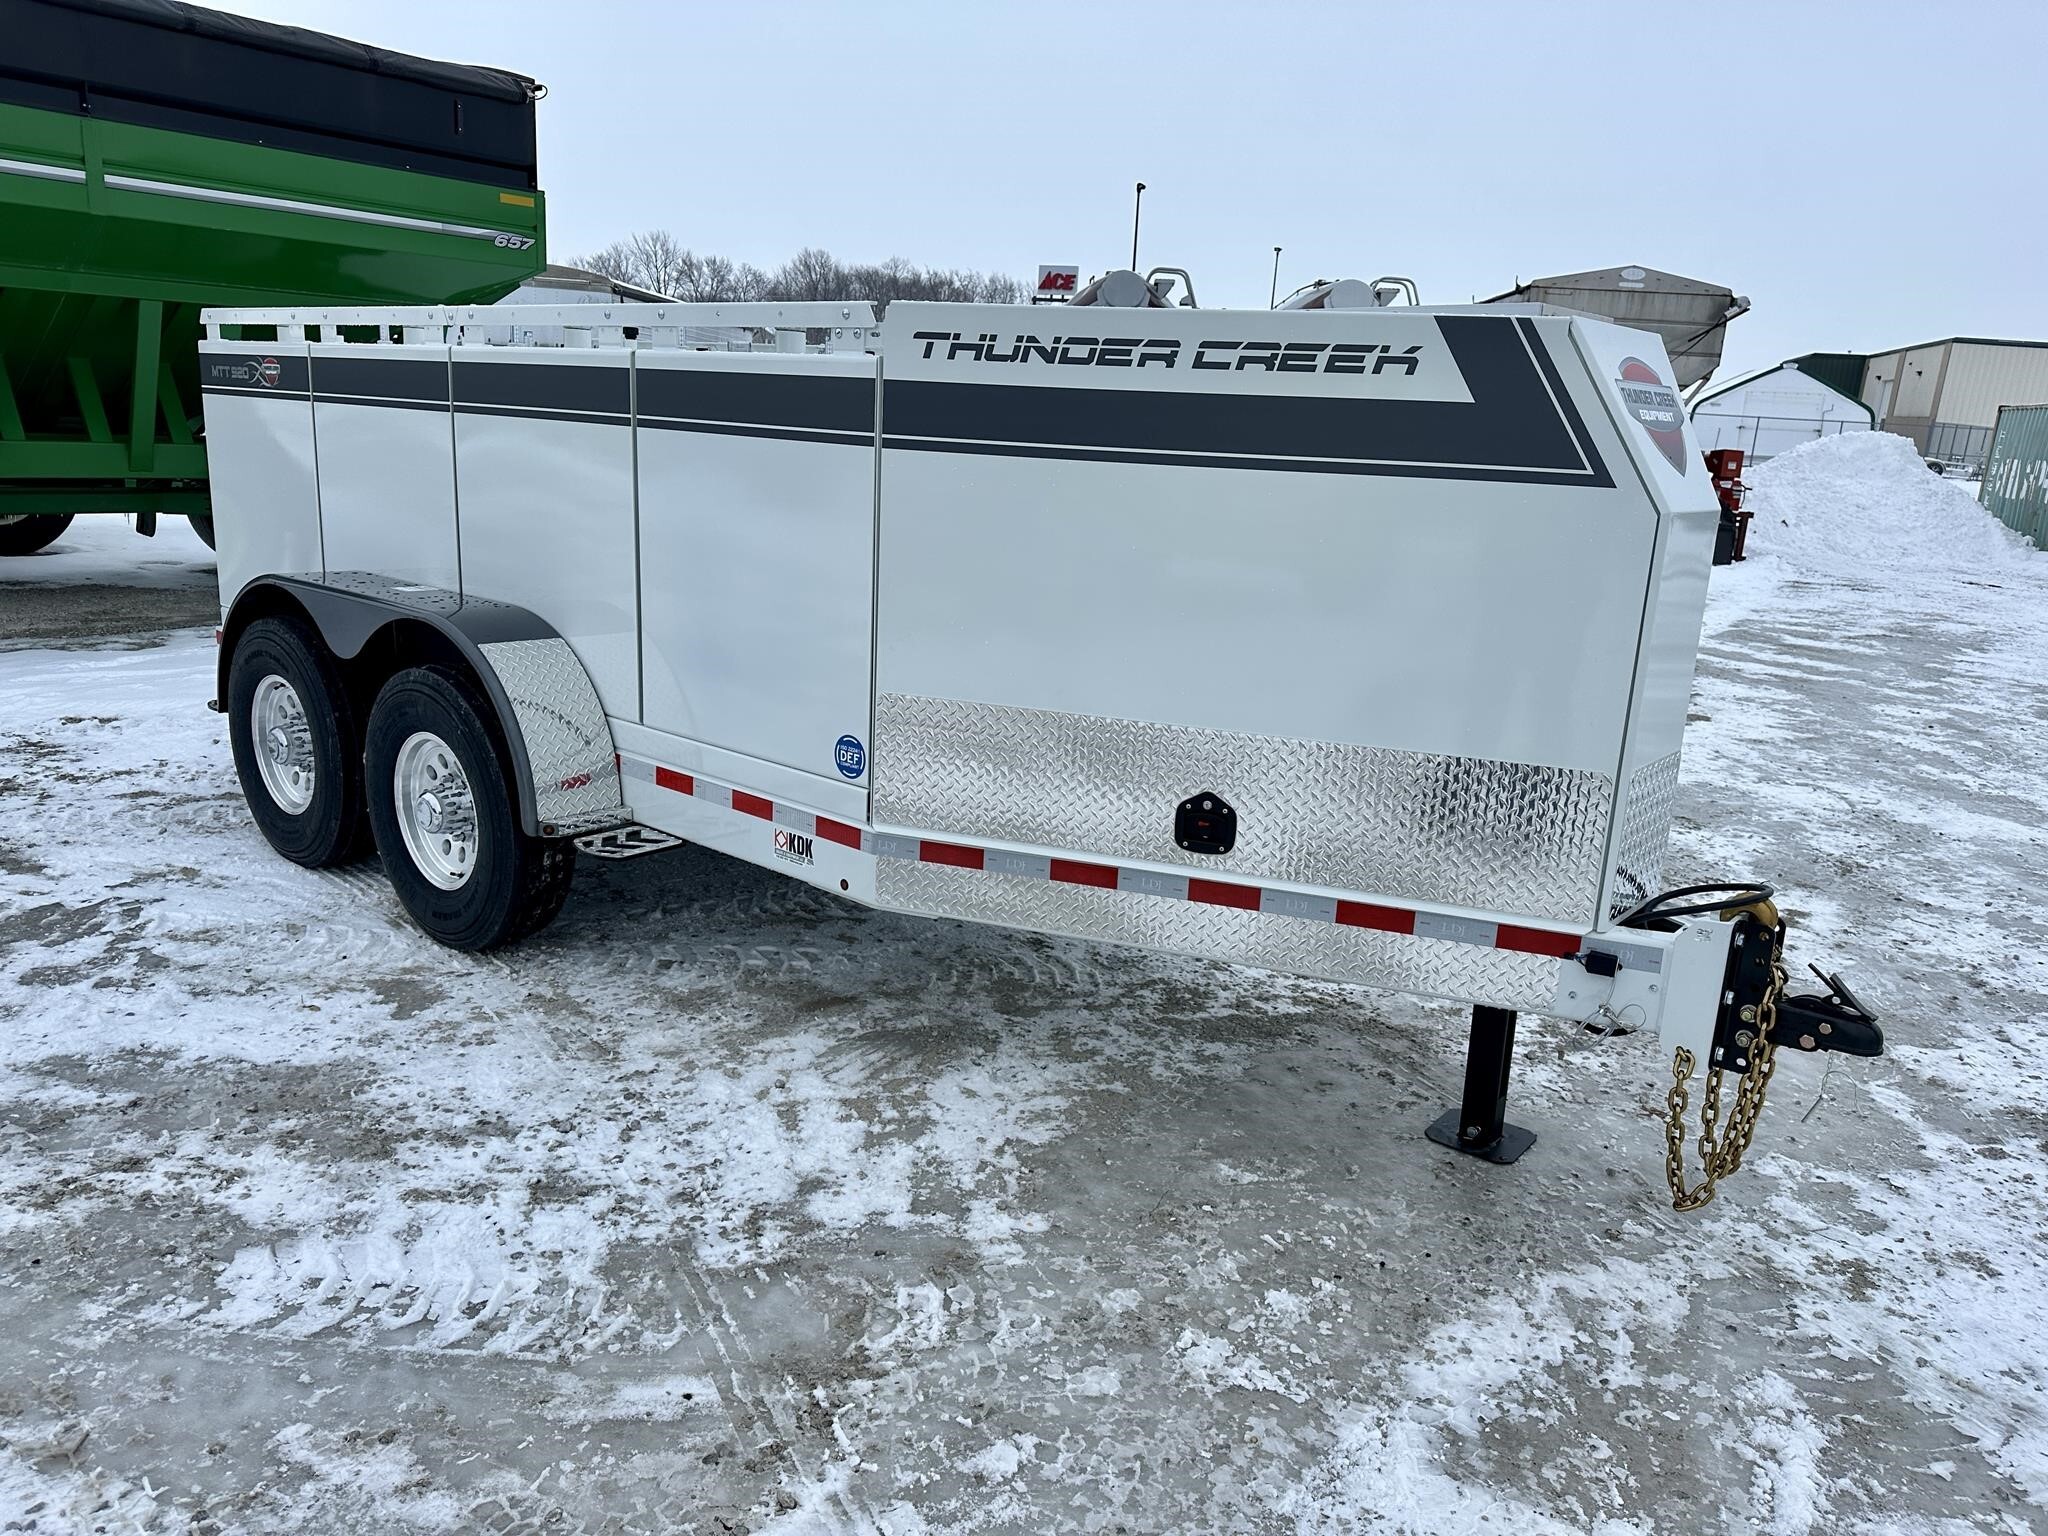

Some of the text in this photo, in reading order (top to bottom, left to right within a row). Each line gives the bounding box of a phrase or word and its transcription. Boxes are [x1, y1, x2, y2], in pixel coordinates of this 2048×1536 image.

[495, 233, 536, 250] 657
[1038, 270, 1077, 290] ACE
[912, 331, 1425, 376] THUNDER CREEK
[211, 365, 230, 378] MTT
[231, 366, 250, 379] 920
[1620, 387, 1680, 409] THUNDER CREEK
[1639, 409, 1675, 423] EQUIPMENT
[840, 750, 860, 765] DEF
[788, 832, 814, 860] KDK
